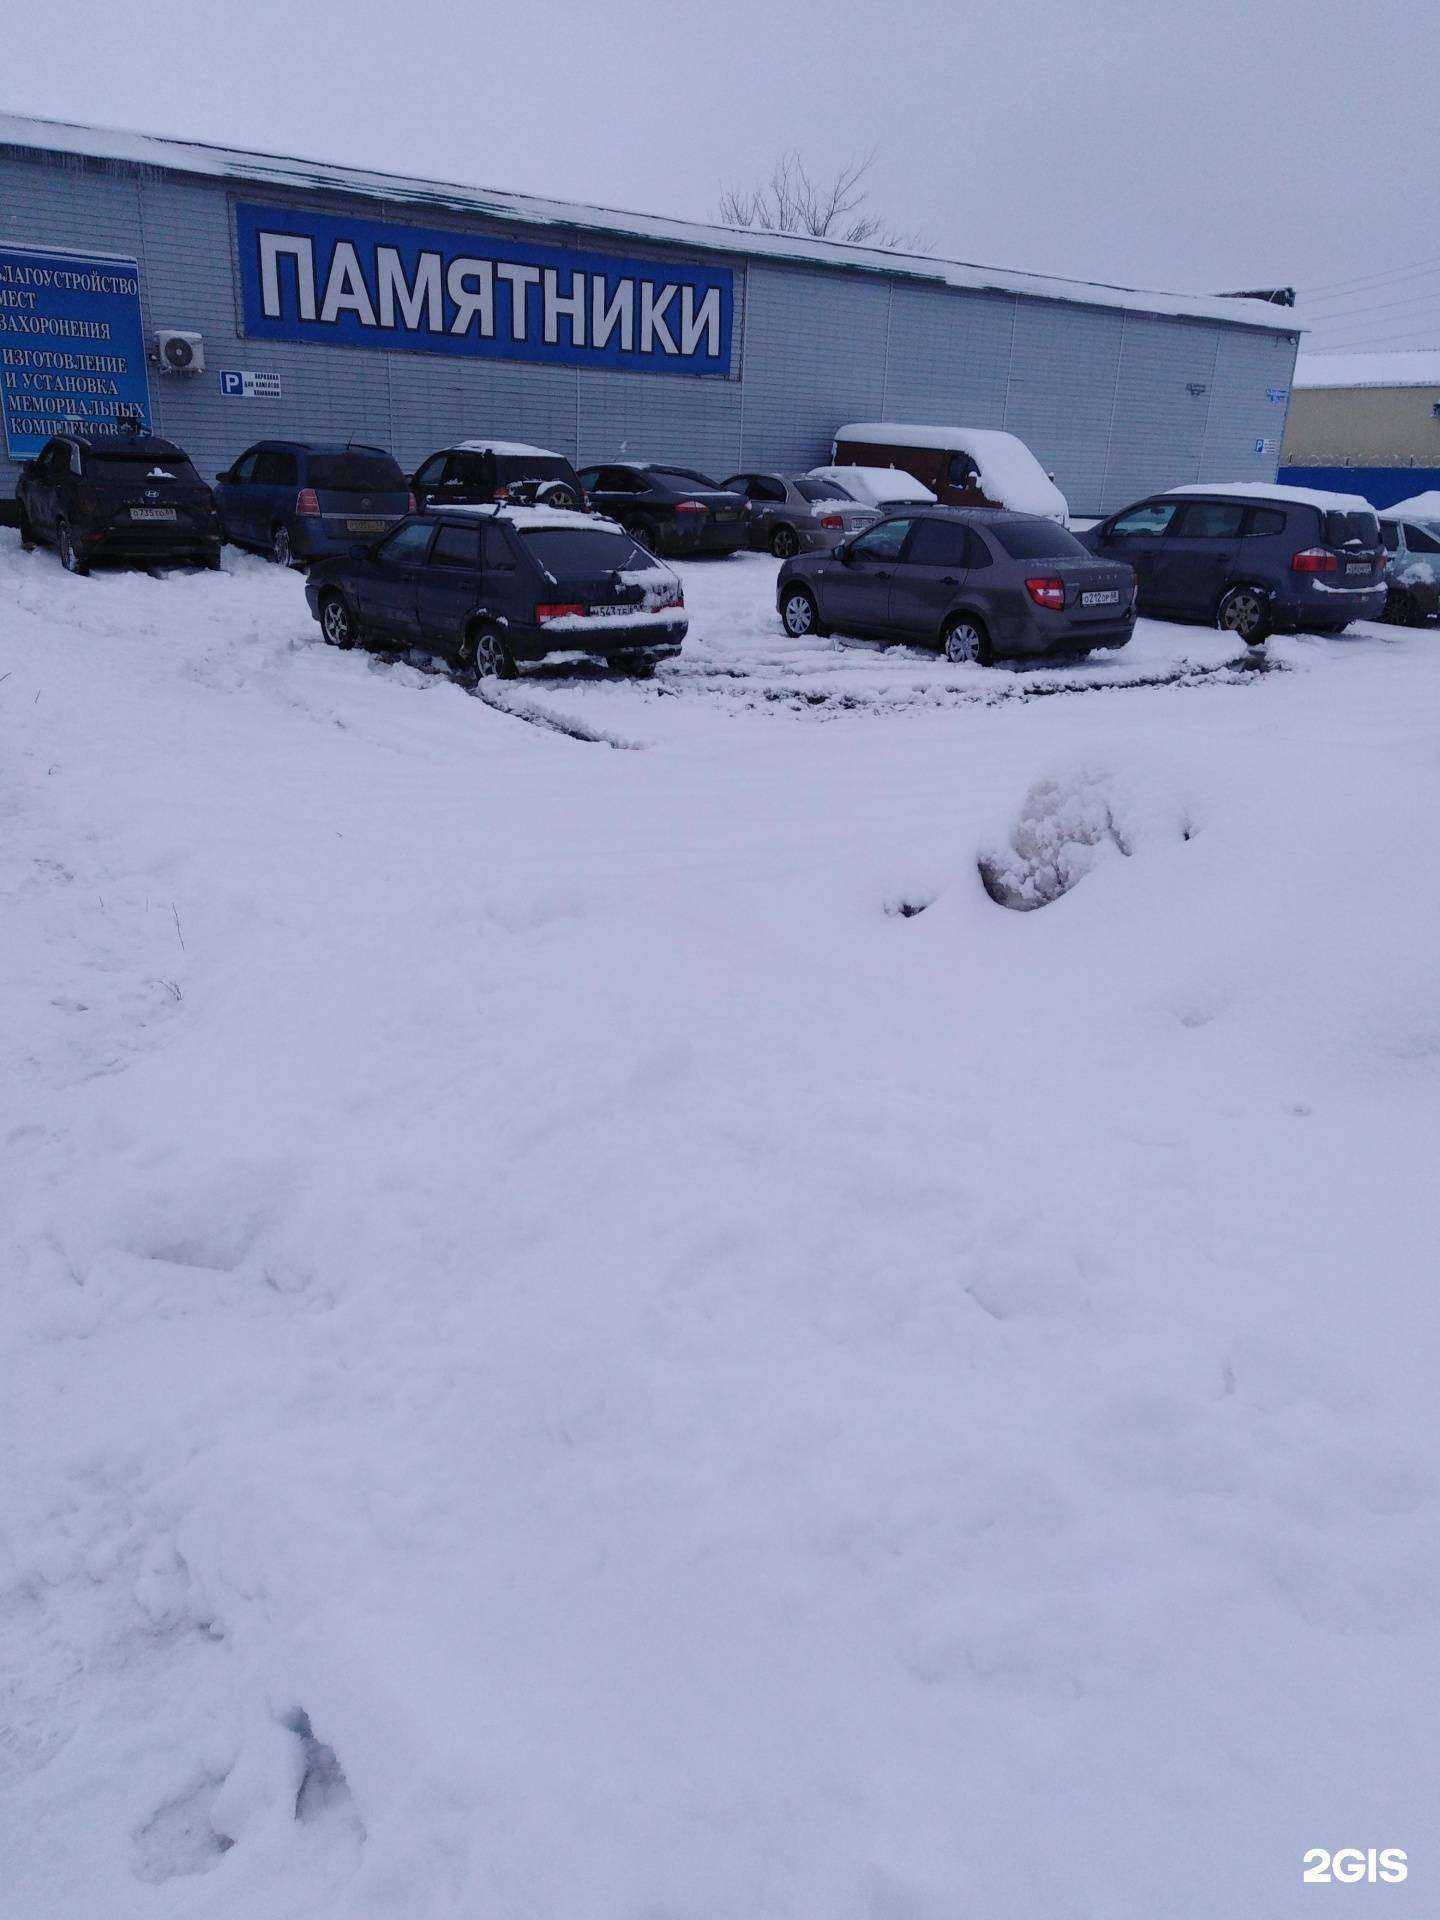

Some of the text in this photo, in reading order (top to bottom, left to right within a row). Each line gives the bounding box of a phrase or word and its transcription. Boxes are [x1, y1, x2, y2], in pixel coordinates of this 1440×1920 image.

[0, 264, 138, 296] ЛАГОУСТРОЙСТВО
[257, 230, 721, 358] ПАМЯТНИКИ
[0, 313, 111, 340] ЗАХОРОНЕНИЯ
[3, 349, 128, 374] ИЗГОТОВЛЕНИЕ
[5, 372, 119, 395] И УСТАНОВКА
[225, 374, 240, 393] P
[8, 395, 146, 418] МЕМОРИАЛЬНЫХ
